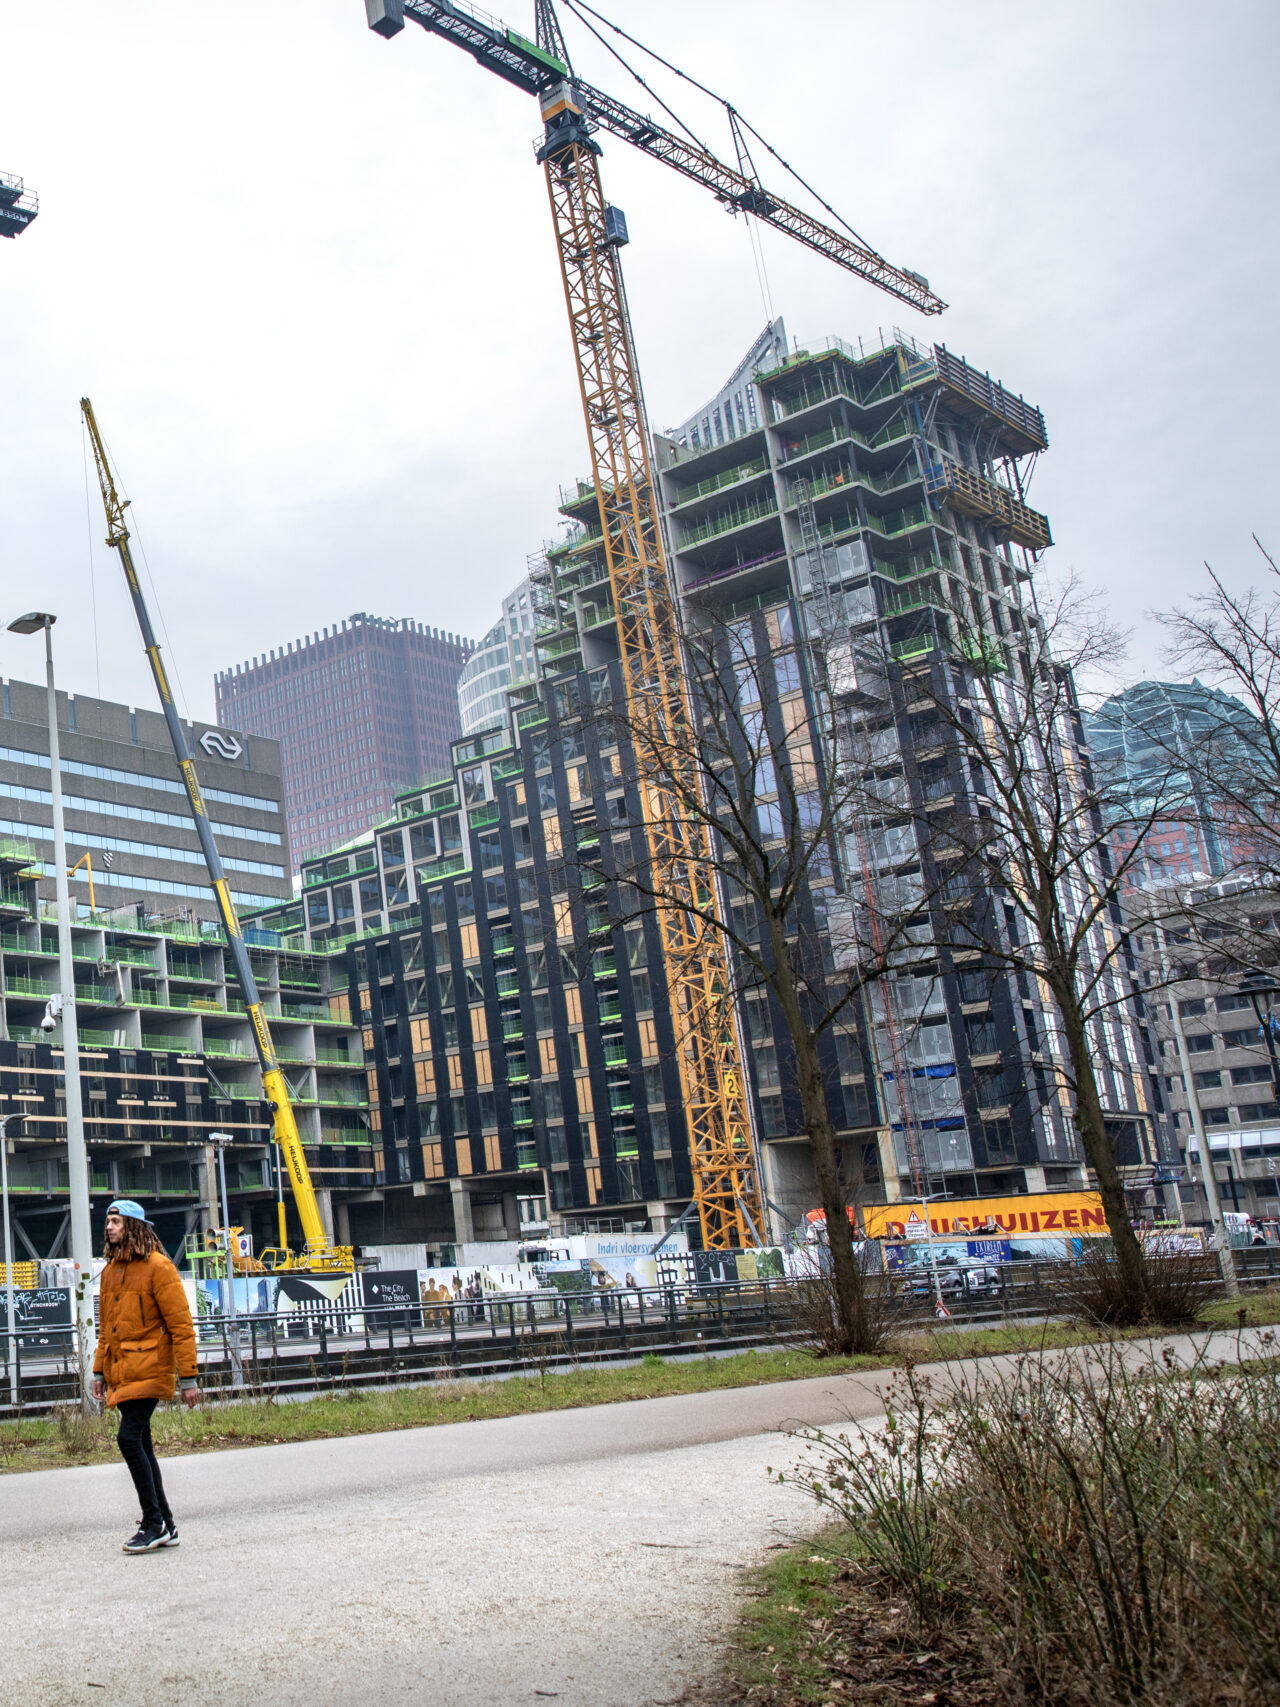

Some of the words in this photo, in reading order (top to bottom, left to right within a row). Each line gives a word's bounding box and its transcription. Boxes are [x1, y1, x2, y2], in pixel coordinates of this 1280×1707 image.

[253, 1011, 268, 1048] HEIJKOOP
[728, 1078, 735, 1094] 2
[289, 1145, 304, 1184] HEIJKOOP
[597, 1242, 618, 1254] Indri
[393, 1284, 404, 1293] City
[382, 1294, 393, 1302] The
[393, 1293, 410, 1301] Beach
